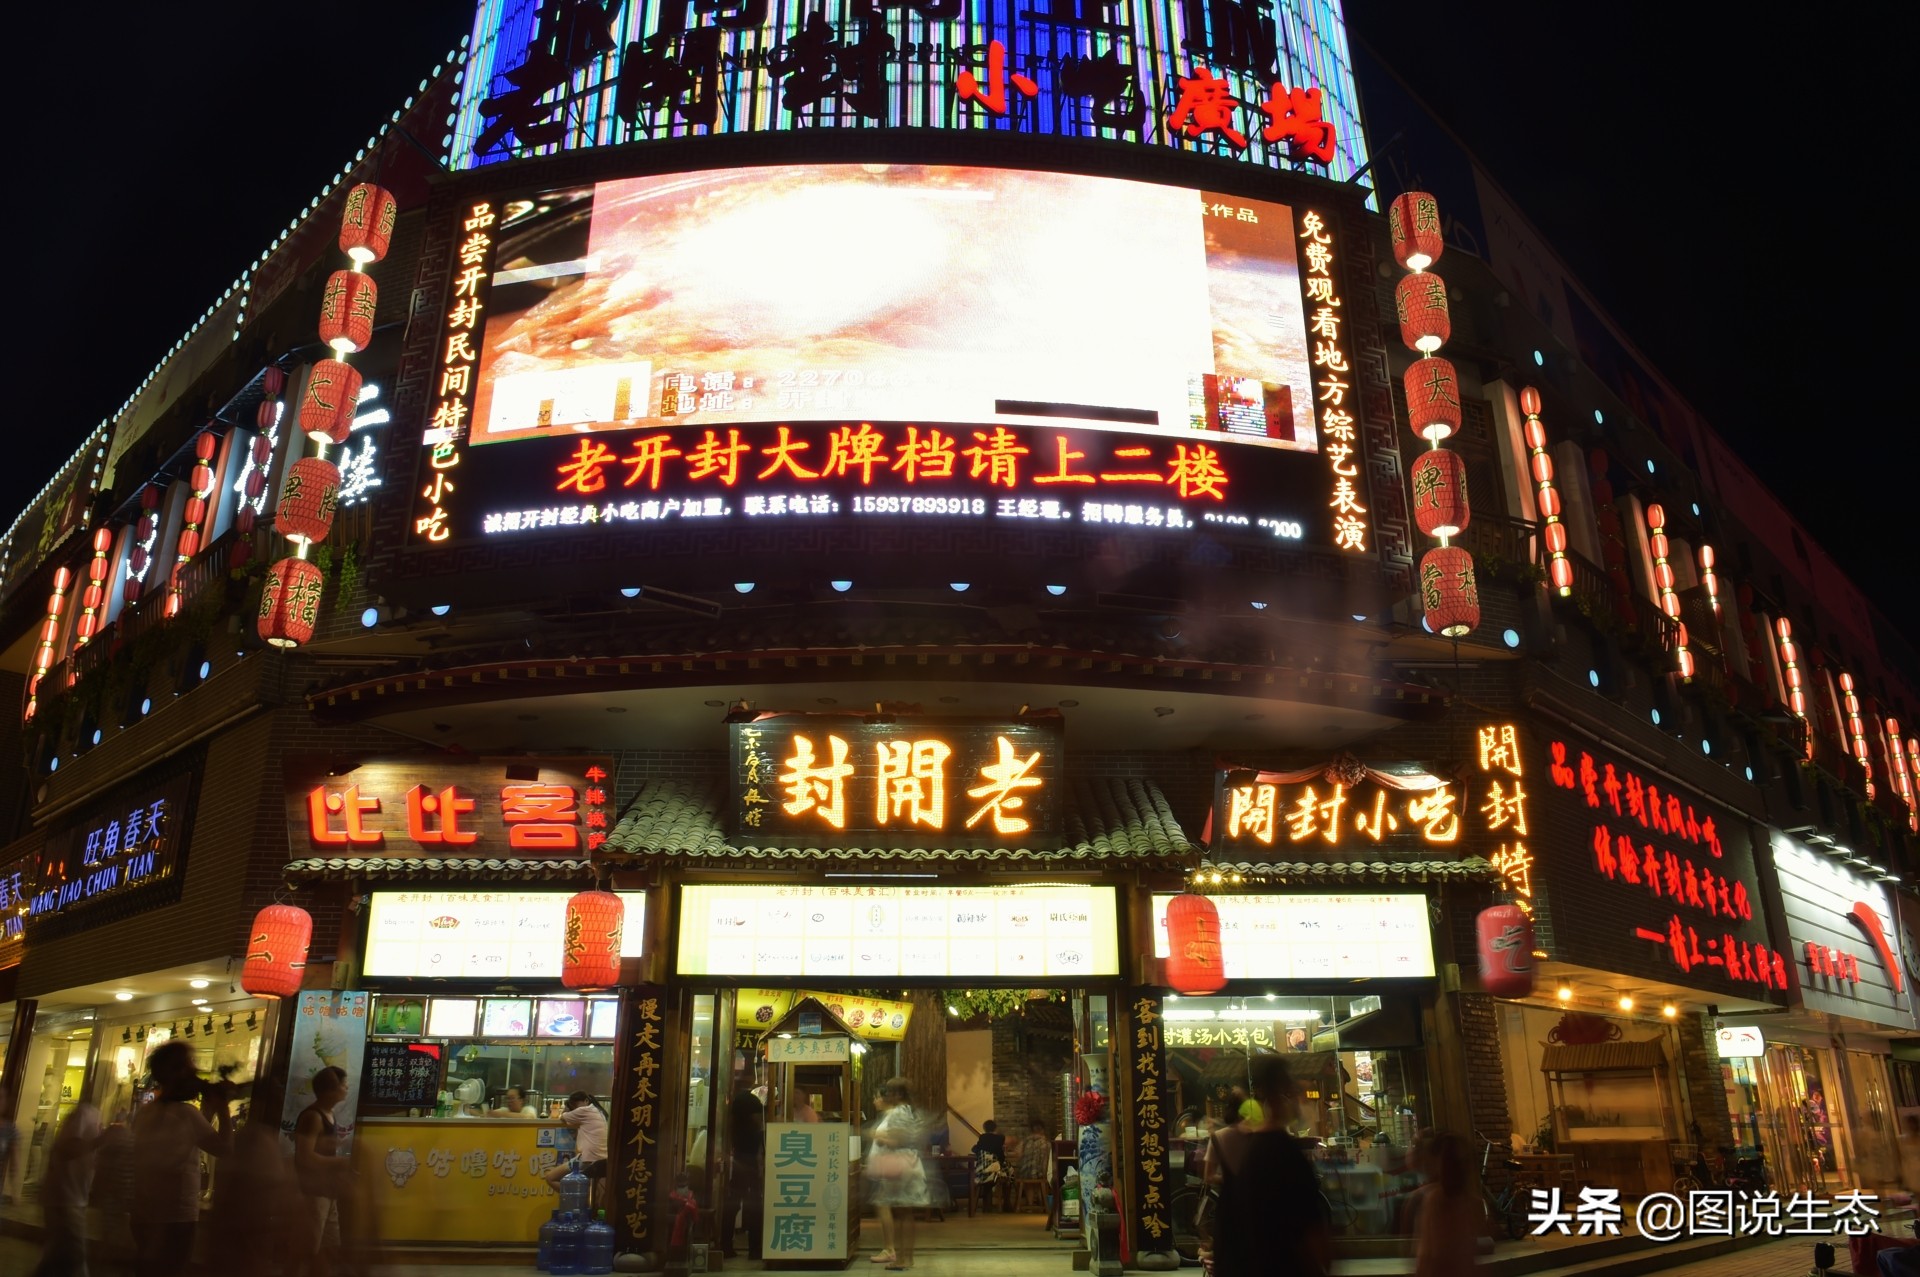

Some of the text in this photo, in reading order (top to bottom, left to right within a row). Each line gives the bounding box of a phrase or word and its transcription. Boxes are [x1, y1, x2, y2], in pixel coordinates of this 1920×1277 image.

[415, 203, 495, 542] 品尝开封民间特色小吃
[1299, 210, 1367, 553] 免费观看地方综艺表演
[556, 424, 1229, 501] 老开封大牌档请上二楼
[853, 496, 985, 514] 15937893918
[83, 798, 166, 866] 旺角春天
[306, 783, 579, 848] 比比客
[29, 850, 156, 916] WANG JIAO CHUN TIAN
[770, 1130, 818, 1253] 臭豆腐
